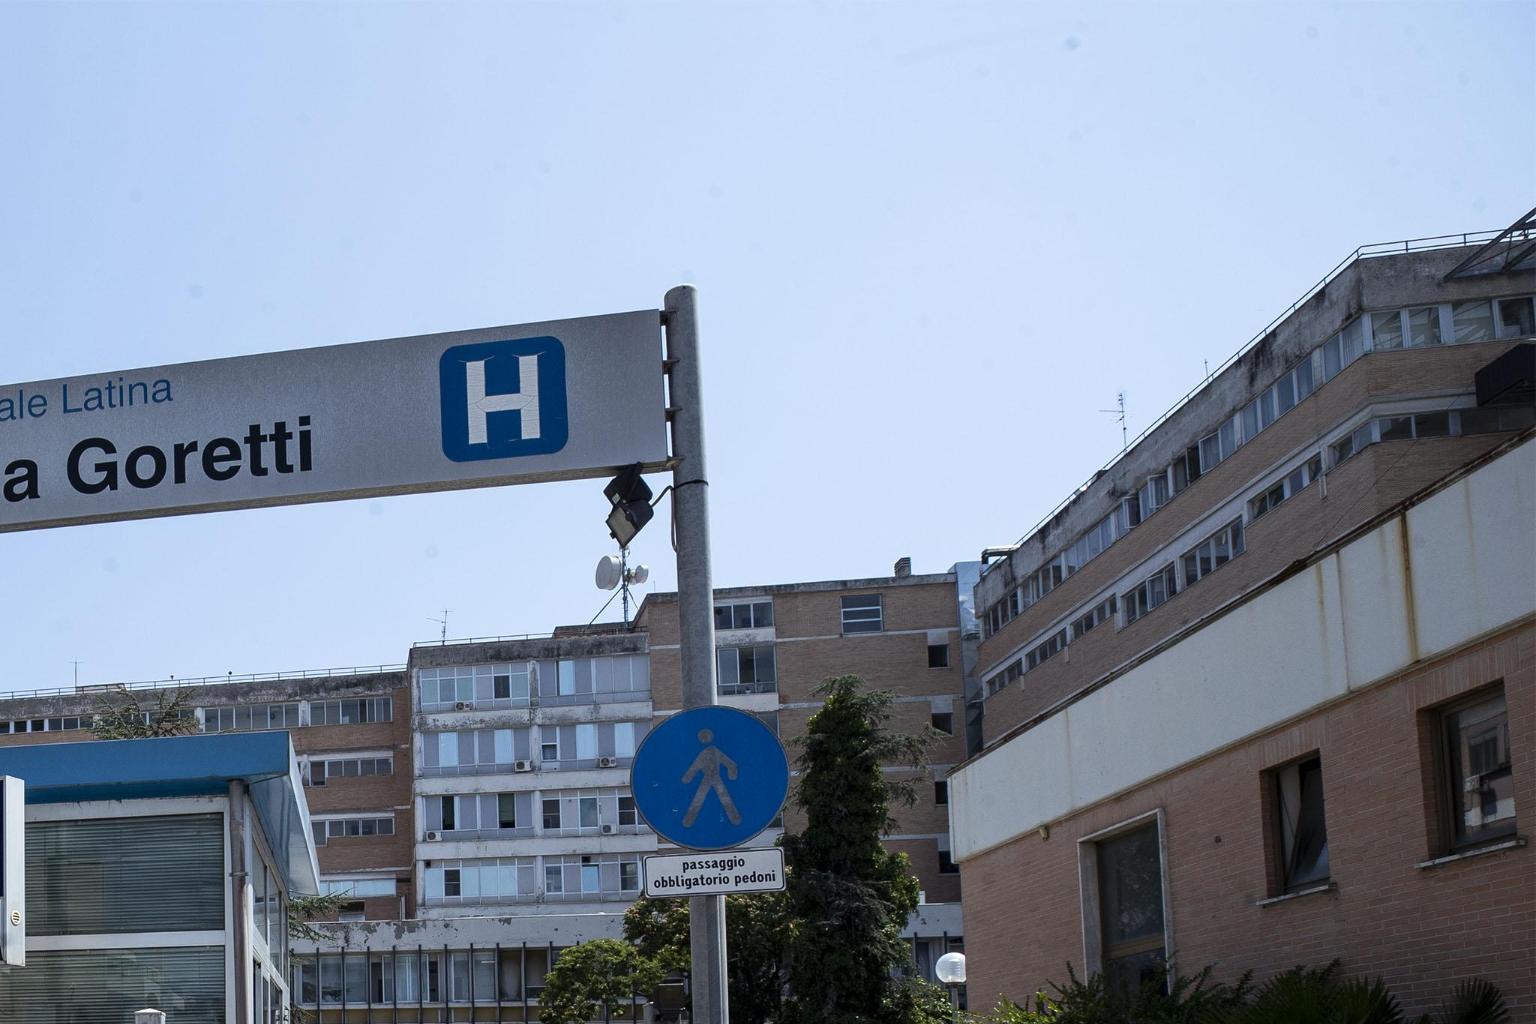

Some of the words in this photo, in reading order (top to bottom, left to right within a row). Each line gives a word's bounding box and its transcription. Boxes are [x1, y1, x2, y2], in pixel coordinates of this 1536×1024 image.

[62, 376, 174, 415] Latina
[465, 353, 542, 446] H
[66, 415, 313, 495] Goretti
[653, 873, 730, 889] obbligatorio
[734, 870, 776, 886] pedoni
[682, 856, 745, 873] passaggio
